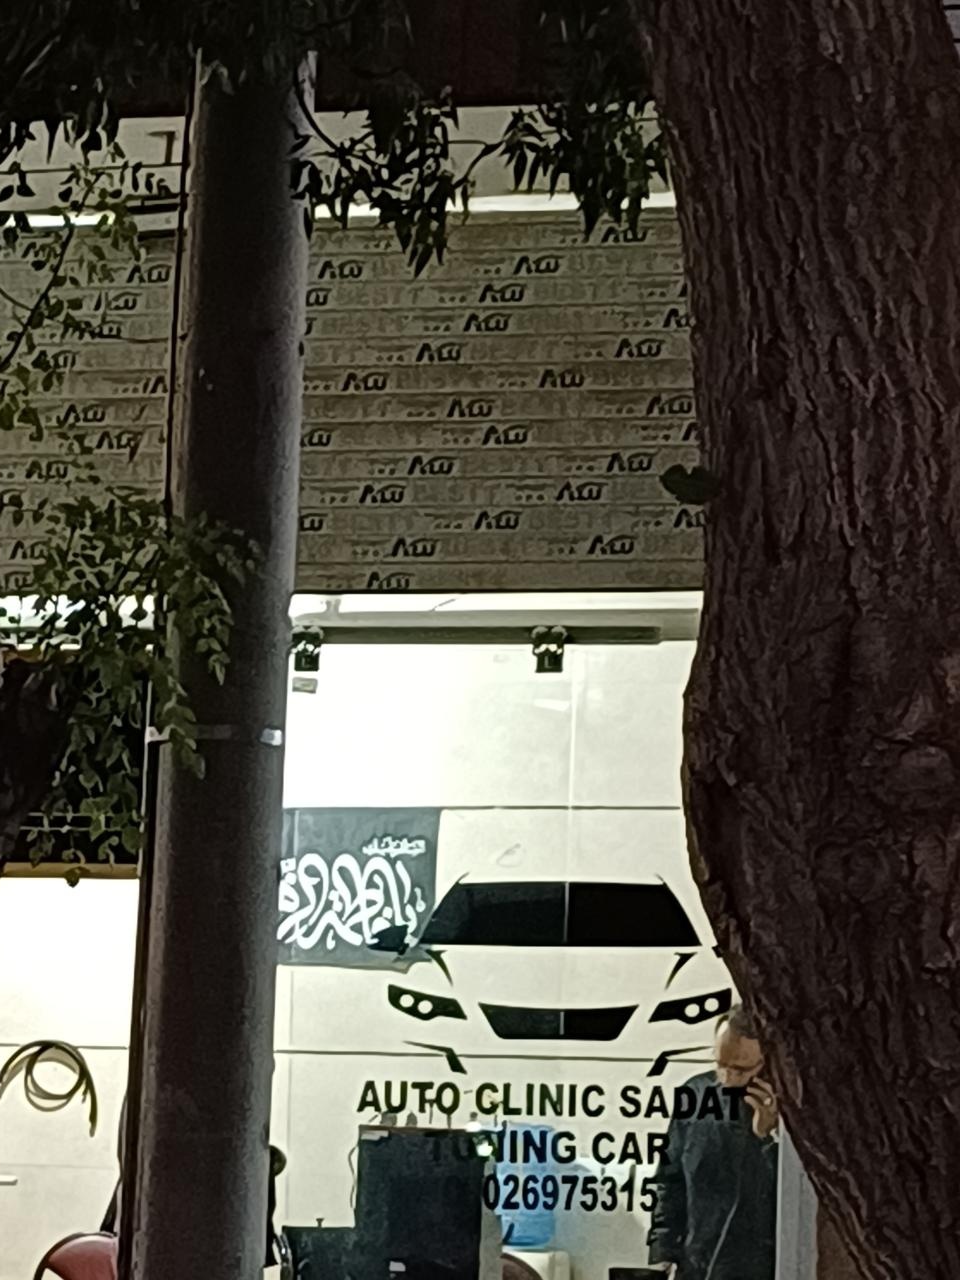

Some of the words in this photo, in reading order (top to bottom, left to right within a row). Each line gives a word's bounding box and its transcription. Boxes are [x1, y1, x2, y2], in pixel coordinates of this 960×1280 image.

[357, 1080, 461, 1115] AUTO
[475, 1082, 606, 1118] CLINIC
[619, 1085, 746, 1121] SADAT
[591, 1131, 672, 1167] CAR
